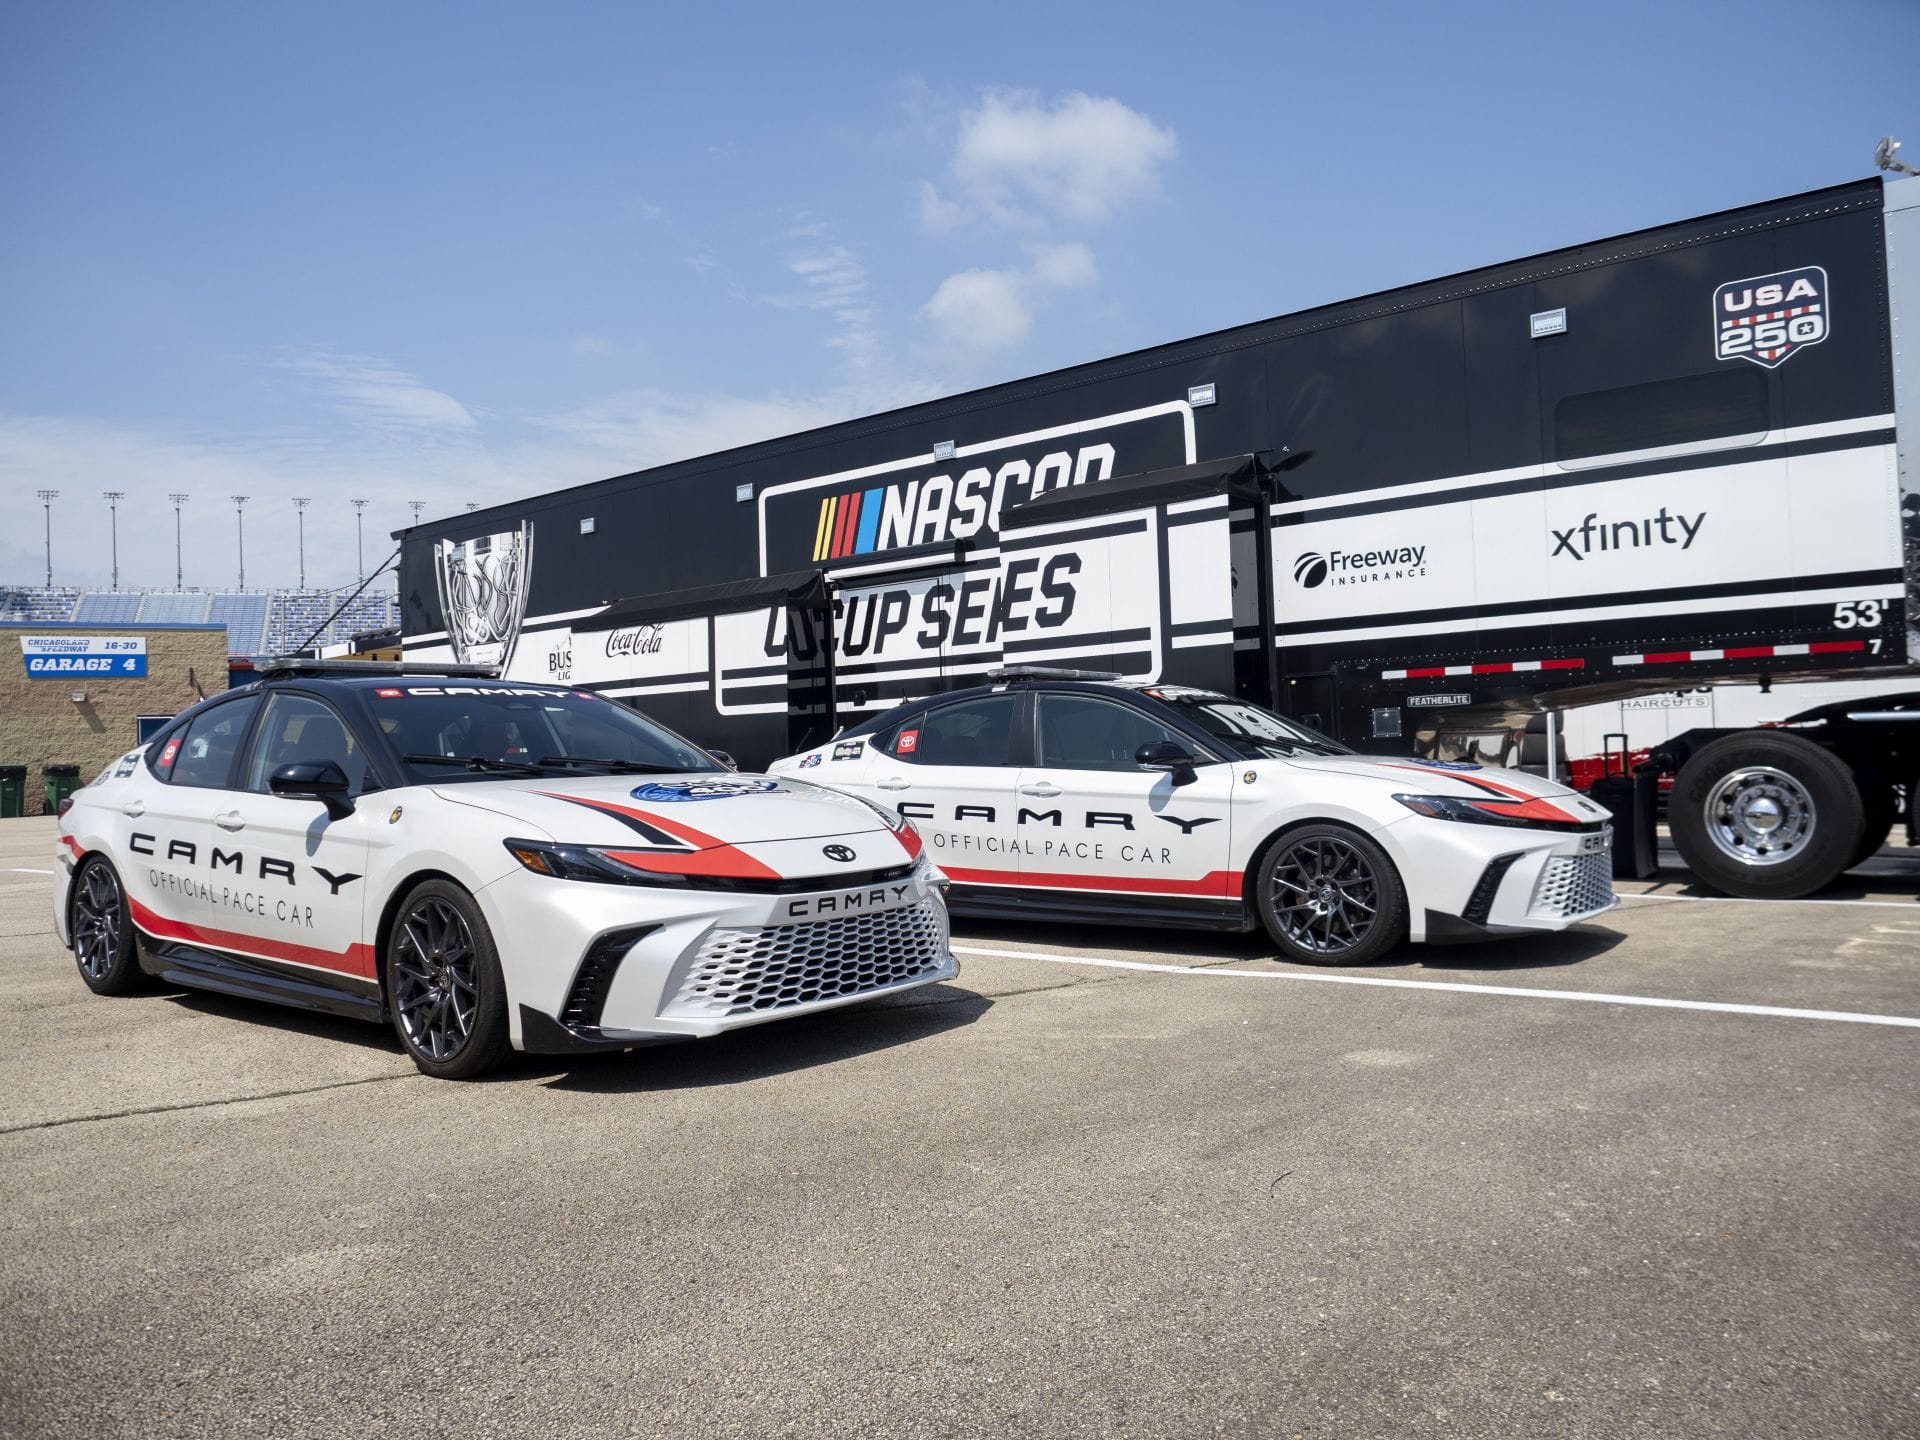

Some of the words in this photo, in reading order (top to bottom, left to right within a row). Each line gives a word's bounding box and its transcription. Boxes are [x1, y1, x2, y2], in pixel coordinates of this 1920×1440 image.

[1724, 278, 1819, 312] USA
[1720, 314, 1824, 356] 250
[1551, 507, 1707, 561] xfinity
[1330, 545, 1426, 571] Freeway
[1331, 568, 1426, 586] INSURANCE
[917, 551, 1082, 650] SEES
[1833, 598, 1889, 629] 53'
[104, 641, 138, 650] 16-30
[1868, 638, 1882, 654] 7
[30, 658, 113, 671] GARAGE
[122, 658, 136, 671] 4
[407, 687, 569, 698] CAMRY
[1410, 695, 1468, 706] FEATHERLITE
[1620, 697, 1705, 709] HAIRCUTS
[896, 801, 1223, 835] CAMRY
[130, 832, 364, 896] CAMRY
[934, 833, 1034, 855] OFFICIAL
[1045, 840, 1104, 861] PACE
[1121, 845, 1171, 865] CAR
[150, 869, 217, 904] OFFICIAL
[223, 886, 265, 916] PACE
[276, 899, 314, 929] CAR
[788, 884, 909, 917] CAMRY
